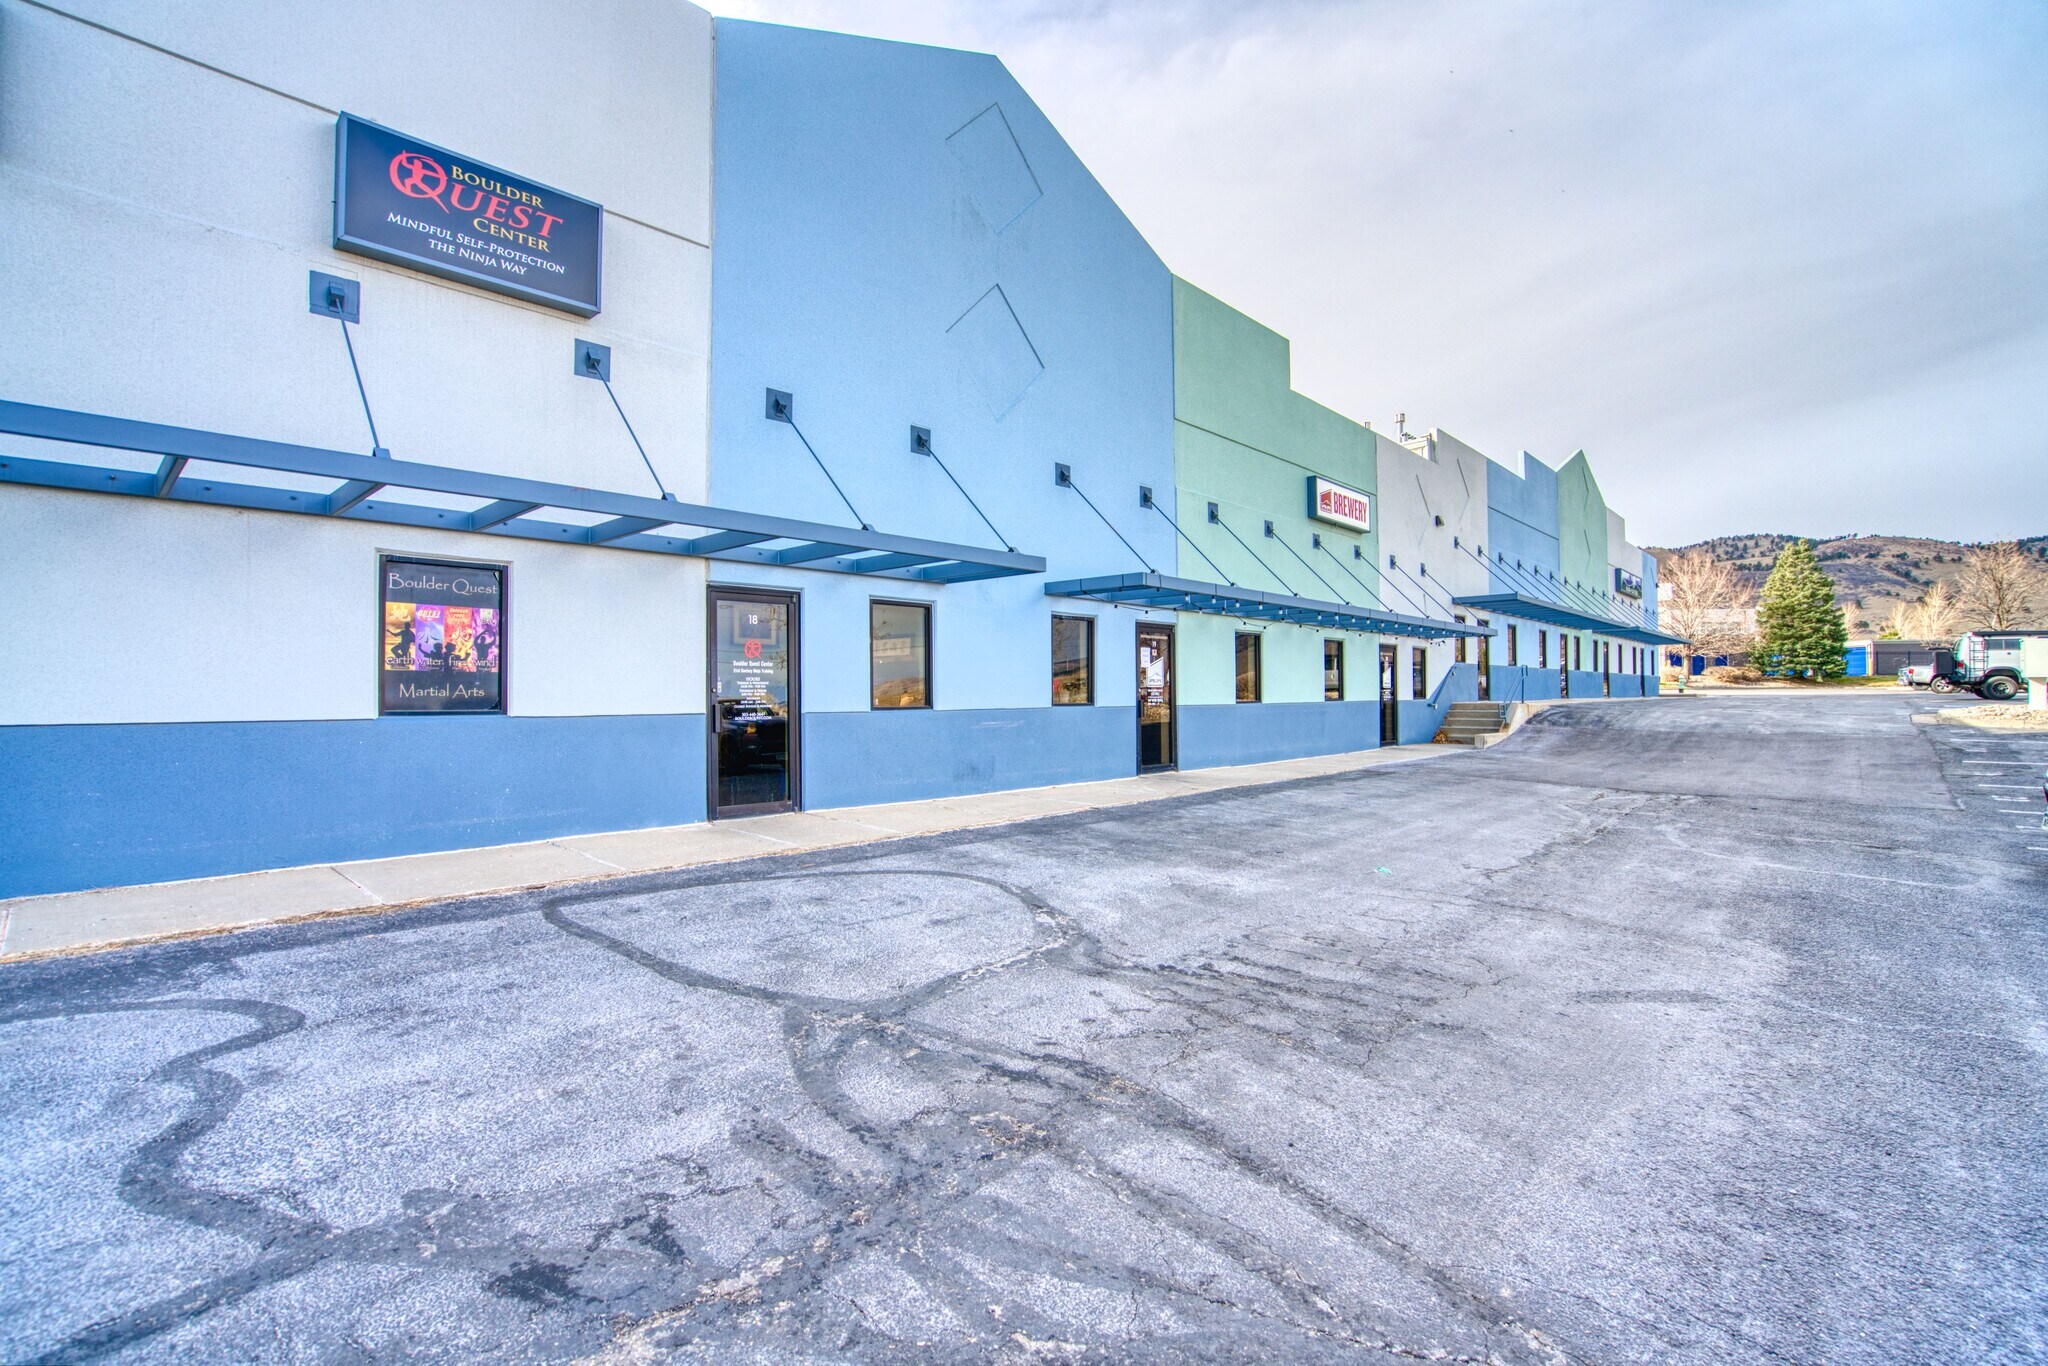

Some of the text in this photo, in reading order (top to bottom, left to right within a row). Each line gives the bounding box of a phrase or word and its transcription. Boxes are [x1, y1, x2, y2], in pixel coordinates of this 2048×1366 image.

[451, 165, 544, 209] BOULDER
[387, 212, 565, 274] MINDFUL SELF-PROTECTION
[473, 218, 550, 253] CENTER
[429, 239, 527, 276] THE NINJA WAY
[1333, 491, 1367, 523] BREWERY
[389, 573, 497, 595] Boulder Quest
[748, 615, 758, 624] 18
[400, 683, 485, 698] Martial Arts
